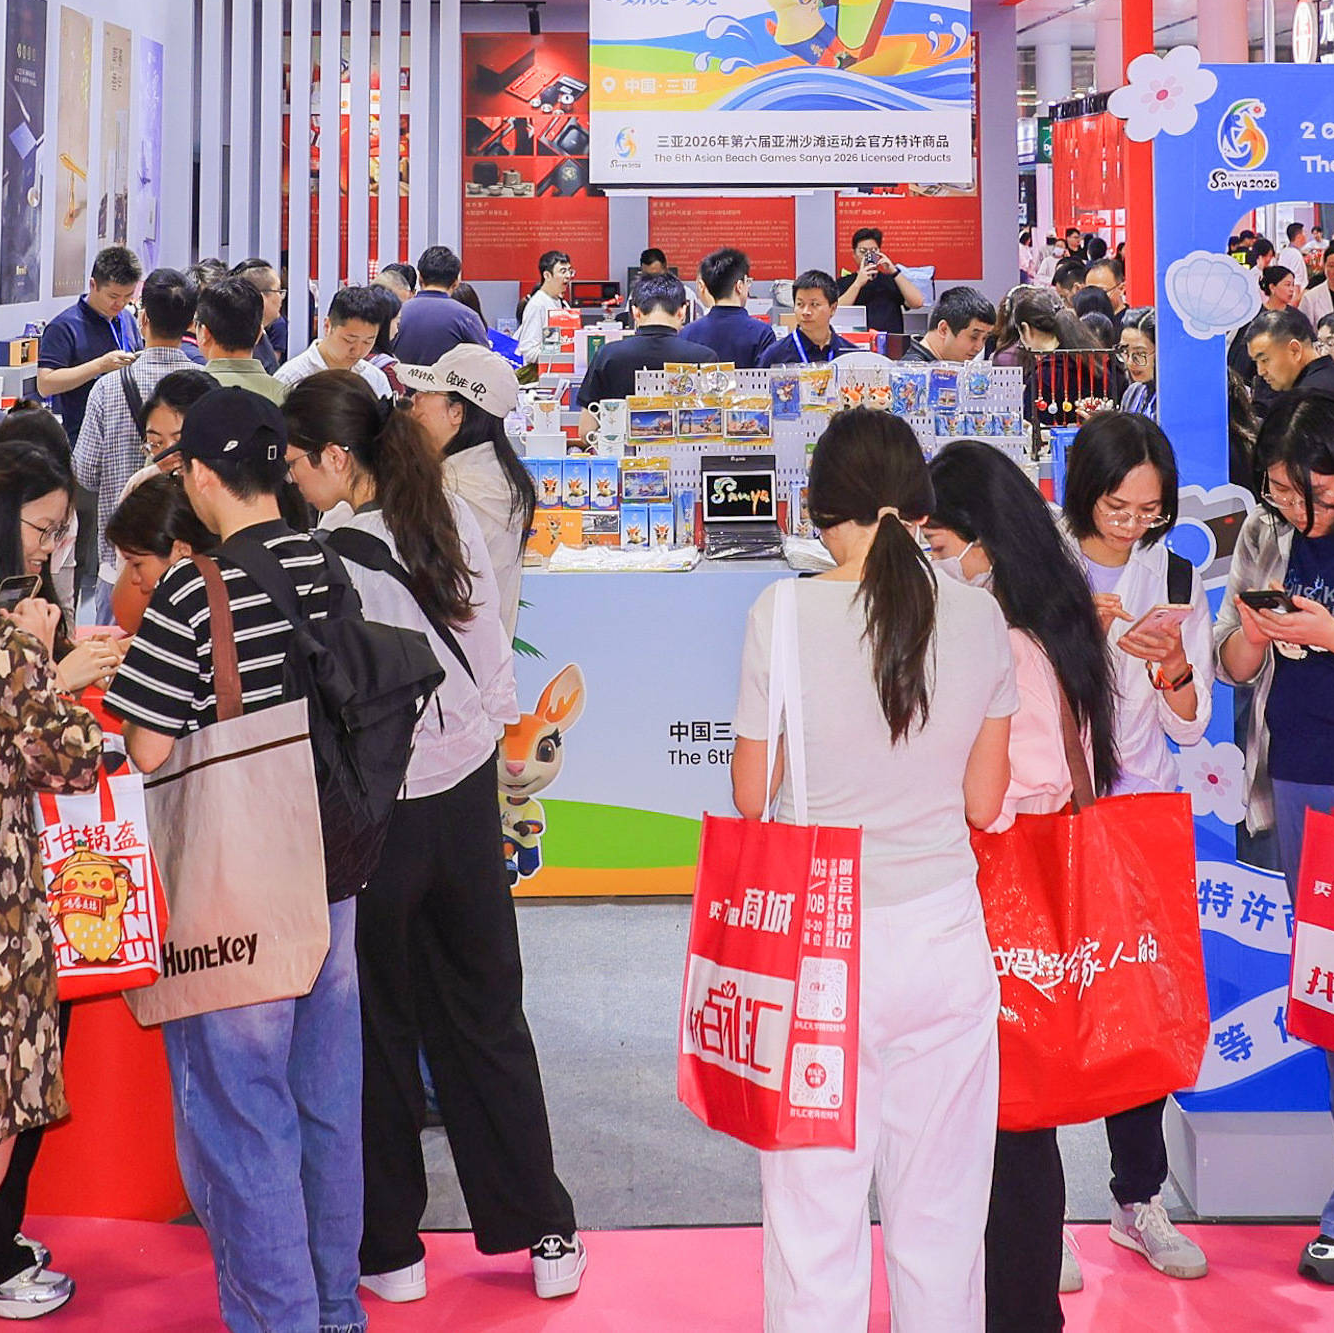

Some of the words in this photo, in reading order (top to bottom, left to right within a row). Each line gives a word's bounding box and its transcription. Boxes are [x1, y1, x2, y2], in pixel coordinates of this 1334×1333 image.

[654, 153, 671, 163] The
[694, 153, 722, 163] Asian
[725, 153, 757, 163] Beach
[760, 153, 796, 164] Games
[799, 153, 831, 164] Sanya
[834, 153, 858, 163] 2026
[860, 153, 905, 163] Licensed
[908, 153, 951, 163] Products
[711, 477, 770, 515] Sanya
[670, 721, 737, 742] 中国三
[668, 749, 701, 765] The
